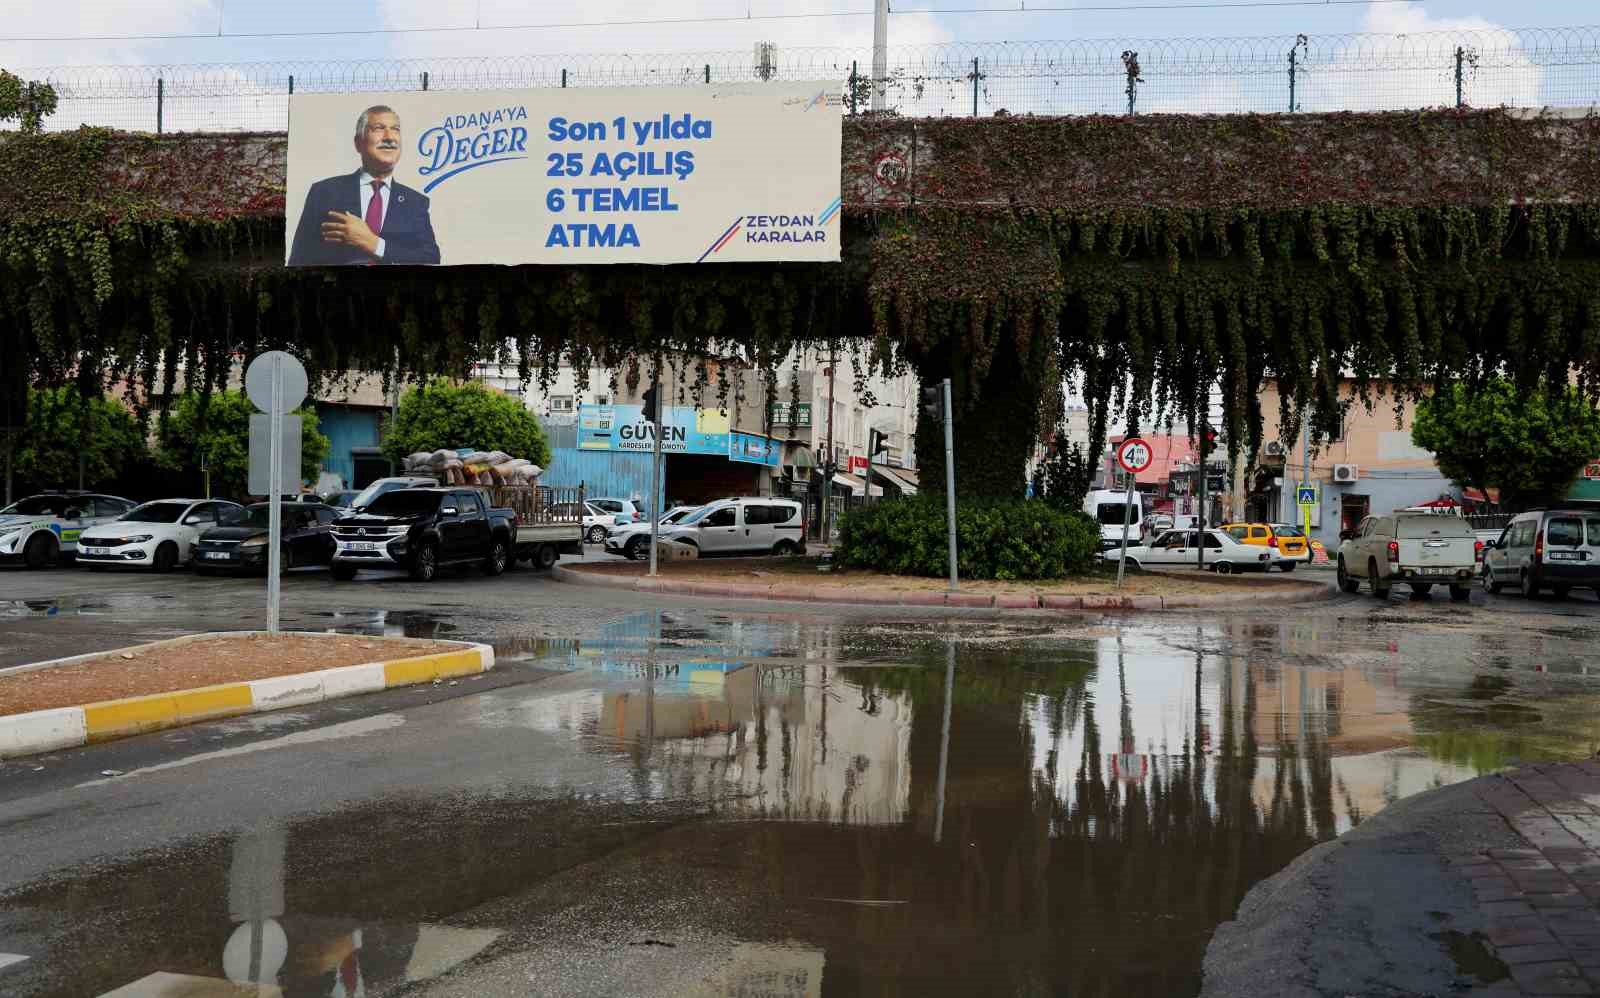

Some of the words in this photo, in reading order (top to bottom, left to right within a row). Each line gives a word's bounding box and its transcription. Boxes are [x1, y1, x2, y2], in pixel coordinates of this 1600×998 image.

[443, 106, 528, 130] ADANA'YA
[547, 117, 607, 142] Son
[612, 116, 626, 141] 1
[632, 113, 713, 146] yılda
[418, 125, 528, 175] DEĞER
[546, 152, 584, 177] 25
[589, 150, 695, 181] AÇILIŞ
[546, 187, 566, 213] 6
[571, 186, 679, 212] TEMEL
[746, 214, 814, 228] ZEYDAN
[544, 223, 641, 248] ATMA
[746, 230, 827, 243] KARALAR
[619, 420, 686, 442] GÜVEN
[1124, 447, 1136, 464] 4
